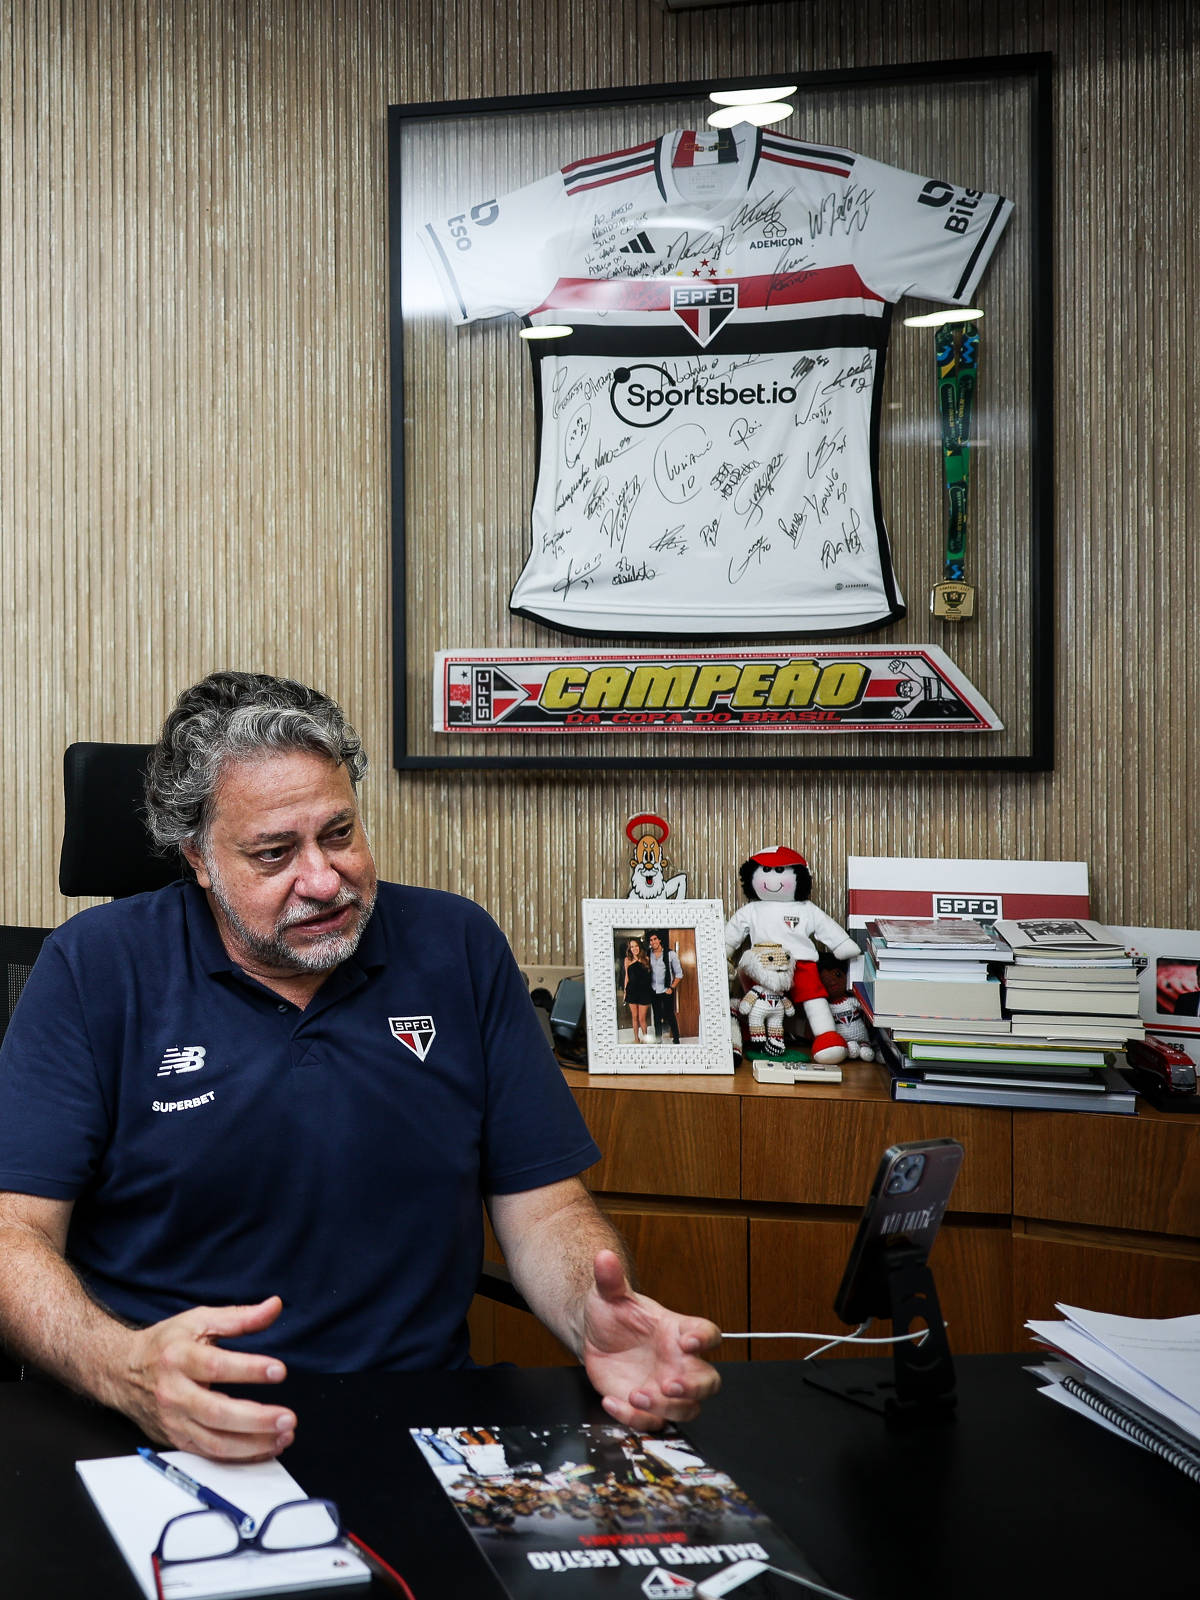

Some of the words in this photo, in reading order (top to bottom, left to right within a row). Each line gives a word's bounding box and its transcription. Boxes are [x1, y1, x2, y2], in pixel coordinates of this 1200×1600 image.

[750, 237, 803, 249] ADEMICON
[676, 290, 733, 305] SPFC
[627, 381, 797, 412] Sportsbet.io
[540, 661, 867, 709] CAMPEÃO
[477, 671, 491, 720] SPFC
[564, 713, 601, 724] DA
[611, 713, 683, 724] COPA
[693, 712, 733, 723] DO
[738, 711, 841, 722] BRASIL
[939, 900, 996, 914] SPFC
[395, 1020, 431, 1031] SPFC
[152, 1091, 215, 1113] SUPERBET
[527, 1549, 620, 1572] GESTÃO
[618, 1547, 659, 1566] DA
[659, 1543, 770, 1565] BALANÇO
